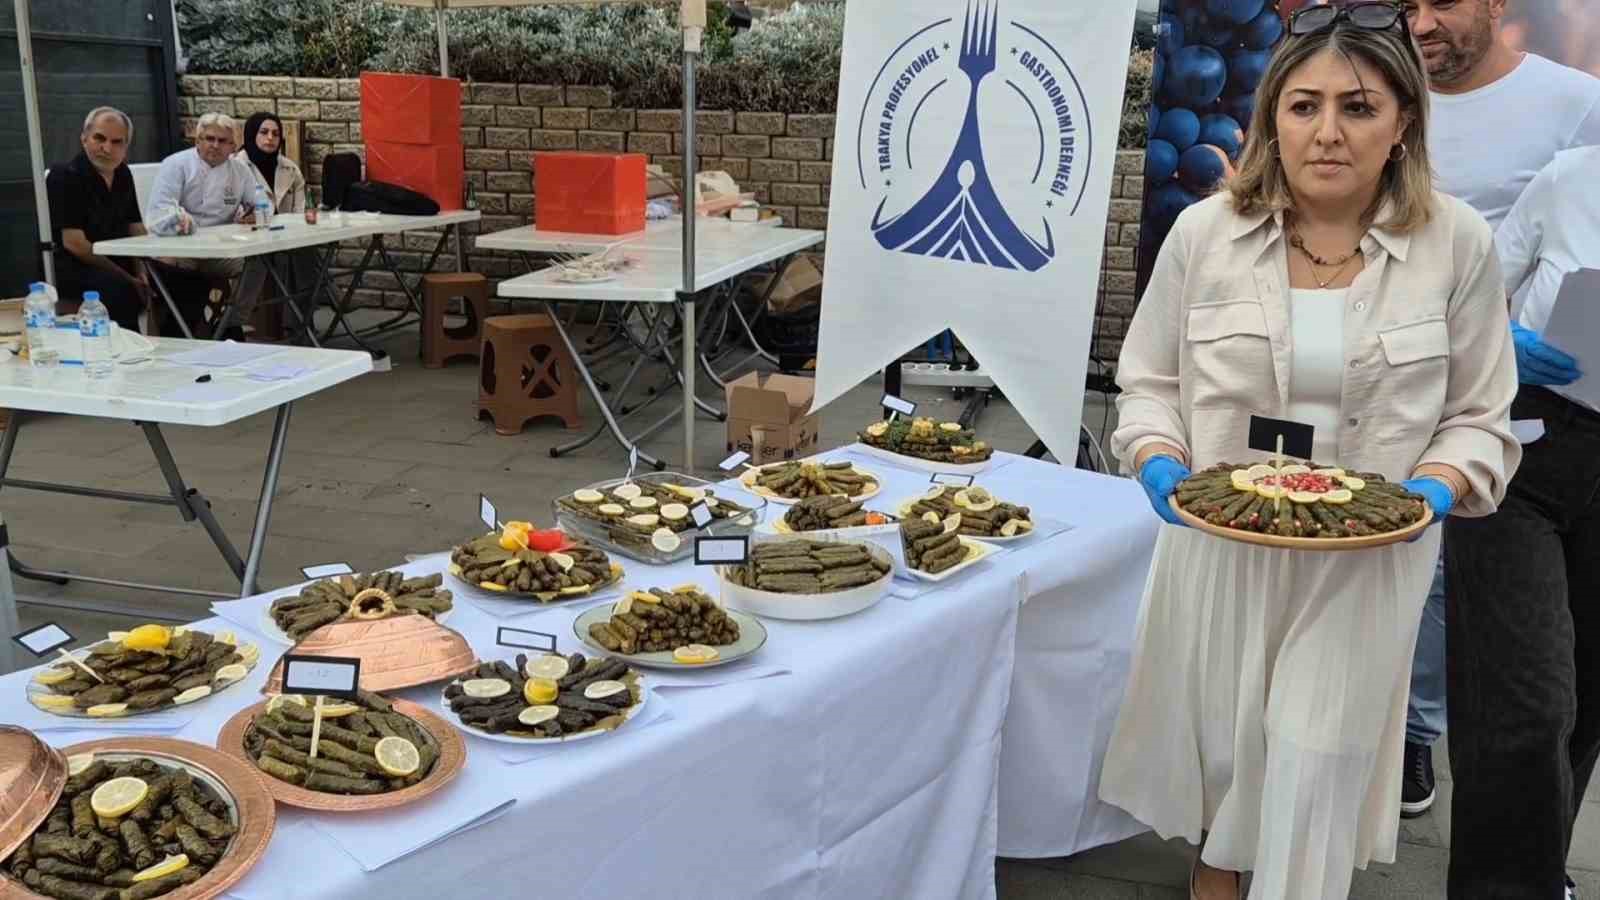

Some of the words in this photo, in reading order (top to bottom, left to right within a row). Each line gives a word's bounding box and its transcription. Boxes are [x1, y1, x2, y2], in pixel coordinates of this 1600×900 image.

[882, 47, 940, 120] PROFESYONEL
[878, 121, 893, 172] TRAKYA
[1019, 50, 1076, 134] GASTRONOMİ
[1050, 136, 1074, 197] DERNEĞİ
